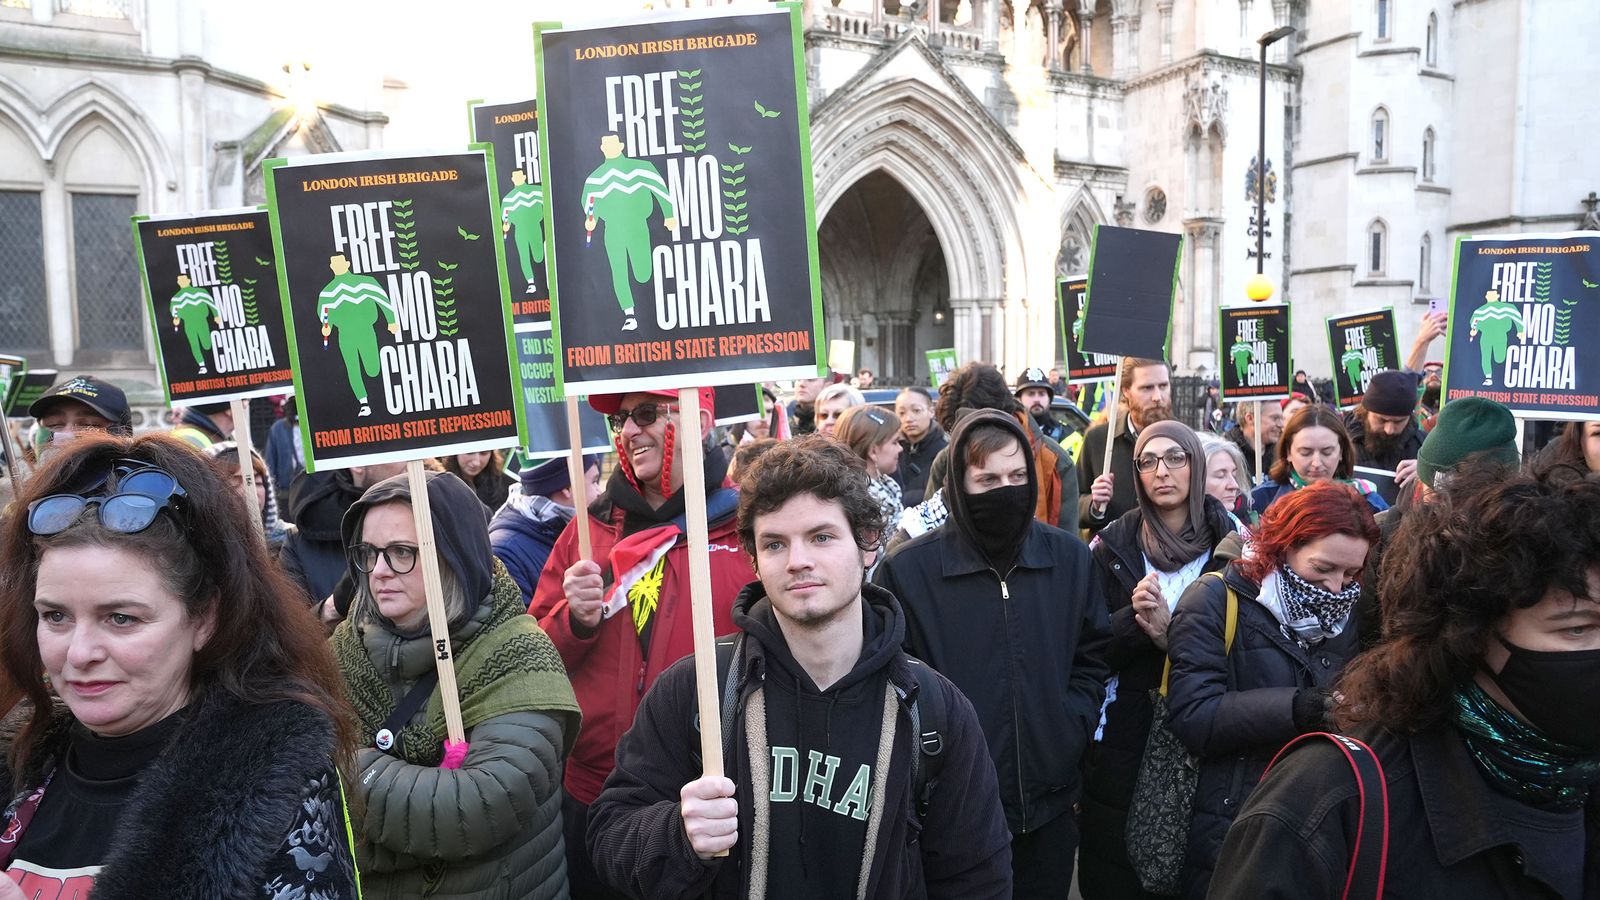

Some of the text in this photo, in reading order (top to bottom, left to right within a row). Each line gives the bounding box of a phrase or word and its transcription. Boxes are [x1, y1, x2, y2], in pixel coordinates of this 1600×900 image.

[575, 33, 757, 60] LONDON IRISH BRIGADE
[495, 111, 533, 125] LONDON
[605, 70, 683, 157] FREE
[514, 130, 541, 184] FR
[303, 170, 458, 192] LONDON IRISH BRIGADE
[666, 154, 722, 242] MO
[157, 226, 194, 237] LONDON
[216, 221, 255, 232] BRIGADE
[330, 200, 400, 274] FREE
[176, 241, 221, 287] FREE
[1478, 244, 1591, 255] LONDON IRISH BRIGADE
[652, 238, 771, 331] CHARA
[1491, 261, 1538, 303] FREE
[211, 284, 246, 330] MO
[386, 271, 438, 342] MO
[522, 299, 550, 315] BRITIS
[1519, 303, 1556, 346] MO
[210, 325, 275, 374] CHARA
[522, 338, 542, 355] END
[567, 330, 810, 368] FROM BRITISH STATE REPRESSION
[1237, 319, 1258, 342] FREE
[1345, 326, 1366, 350] FREE
[1252, 340, 1268, 364] MO
[1361, 346, 1378, 371] MO
[1504, 345, 1576, 390] CHARA
[170, 383, 196, 394] FROM
[196, 379, 226, 392] BRITISH
[226, 374, 248, 388] STATE
[379, 338, 480, 415] CHARA
[1247, 362, 1279, 386] CHARA
[1512, 392, 1538, 404] STATE
[1540, 394, 1599, 407] REPRESSION
[315, 410, 512, 448] FROM BRITISH STATE REPRESSION
